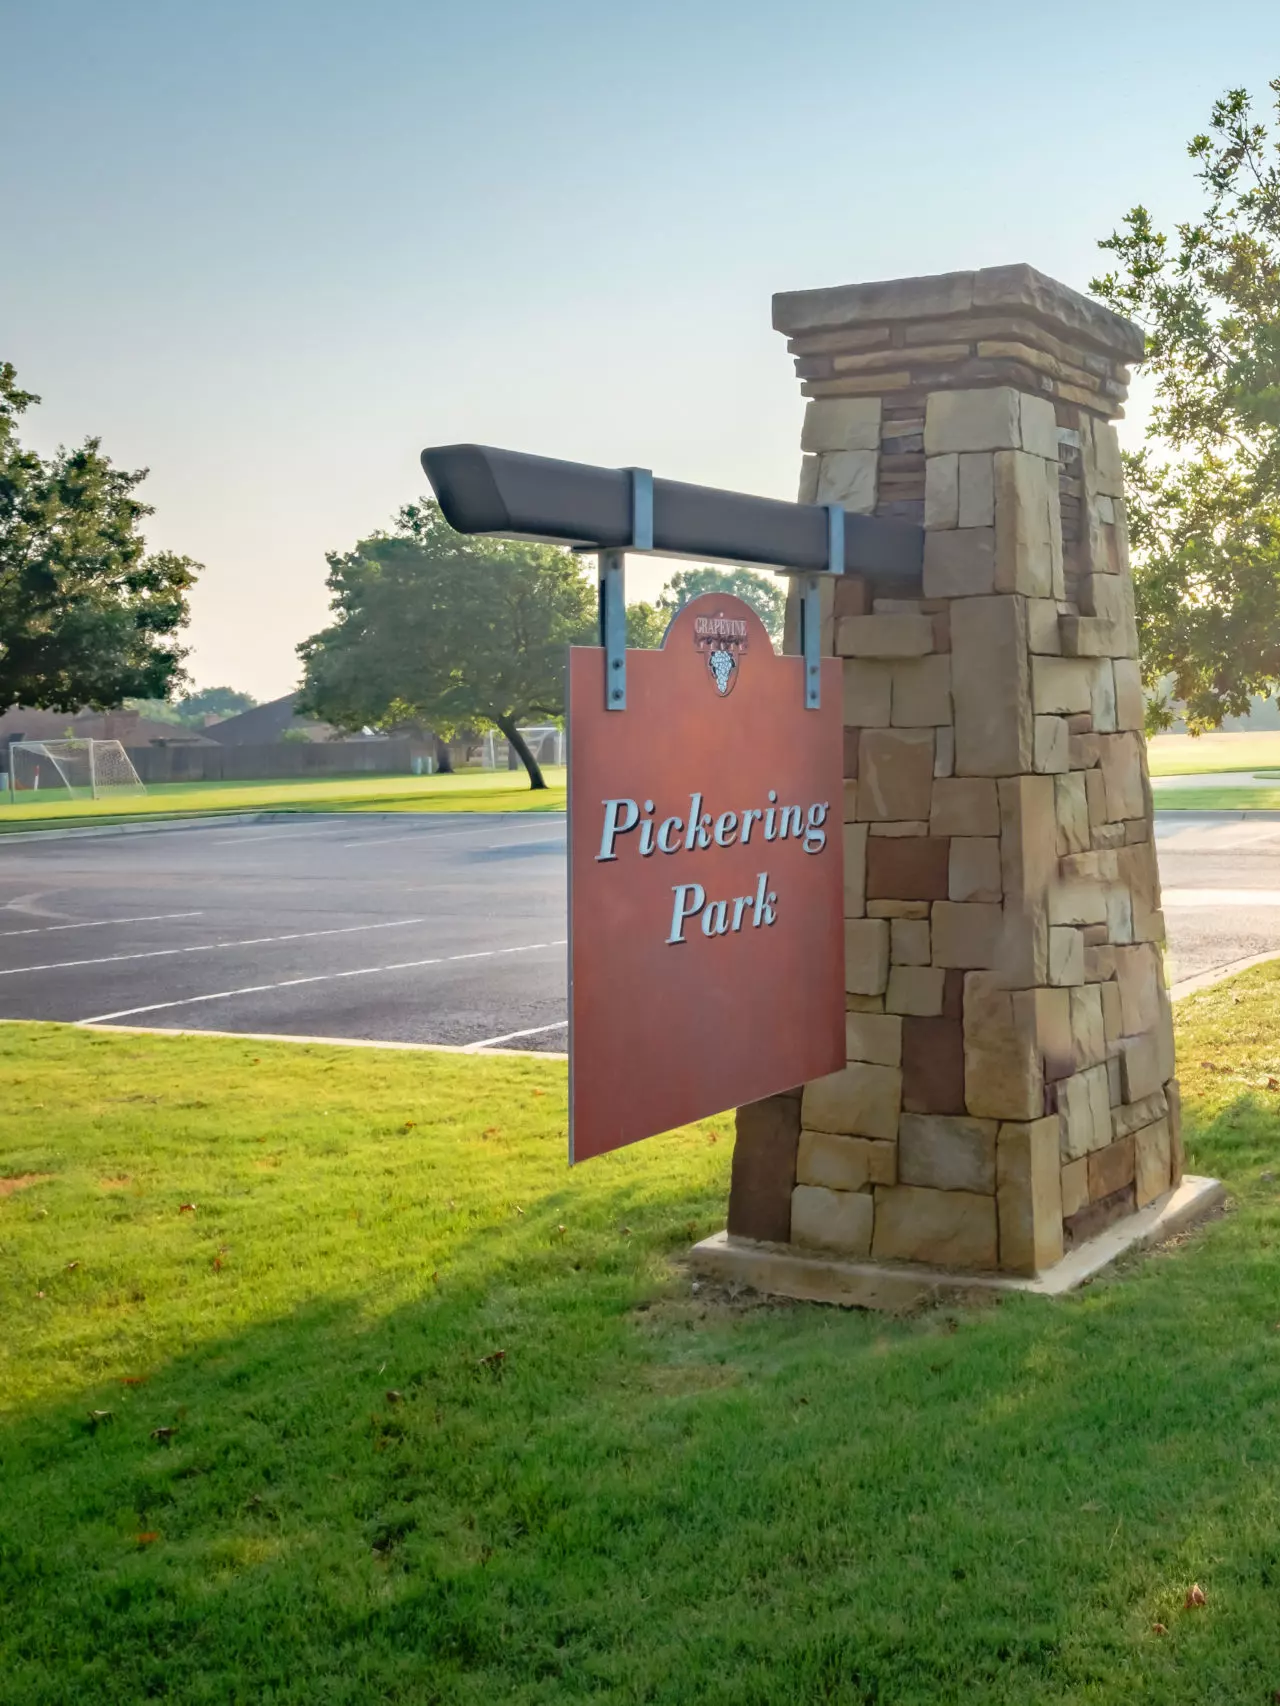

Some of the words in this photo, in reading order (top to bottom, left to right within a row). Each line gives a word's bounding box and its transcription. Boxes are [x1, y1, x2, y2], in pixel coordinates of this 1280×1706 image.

[695, 617, 747, 636] GRAPEVINE
[595, 790, 828, 860] Pickering
[666, 871, 778, 944] Park
